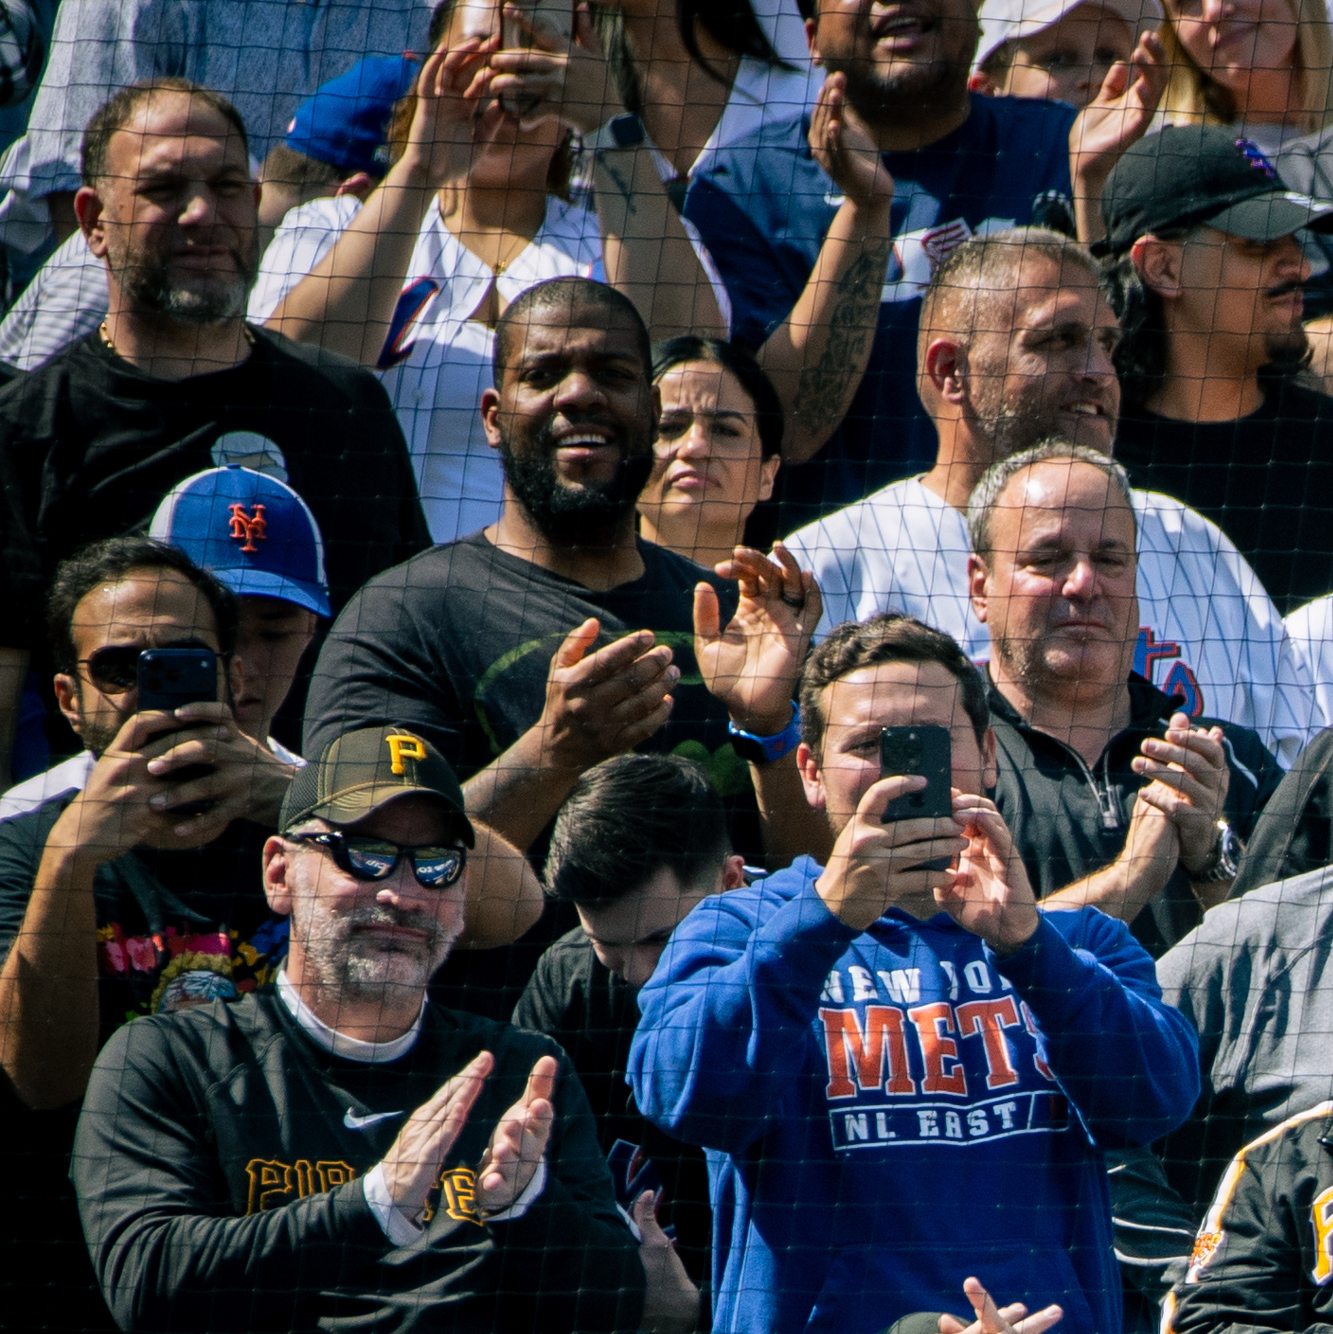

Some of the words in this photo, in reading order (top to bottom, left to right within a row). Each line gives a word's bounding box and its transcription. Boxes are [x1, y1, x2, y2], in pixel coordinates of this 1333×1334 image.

[385, 734, 428, 775] P
[819, 964, 921, 1003] NEW
[818, 995, 1058, 1100] MET
[845, 1112, 896, 1141] NL
[917, 1101, 1016, 1139] EAST
[246, 1157, 487, 1227] PIRE
